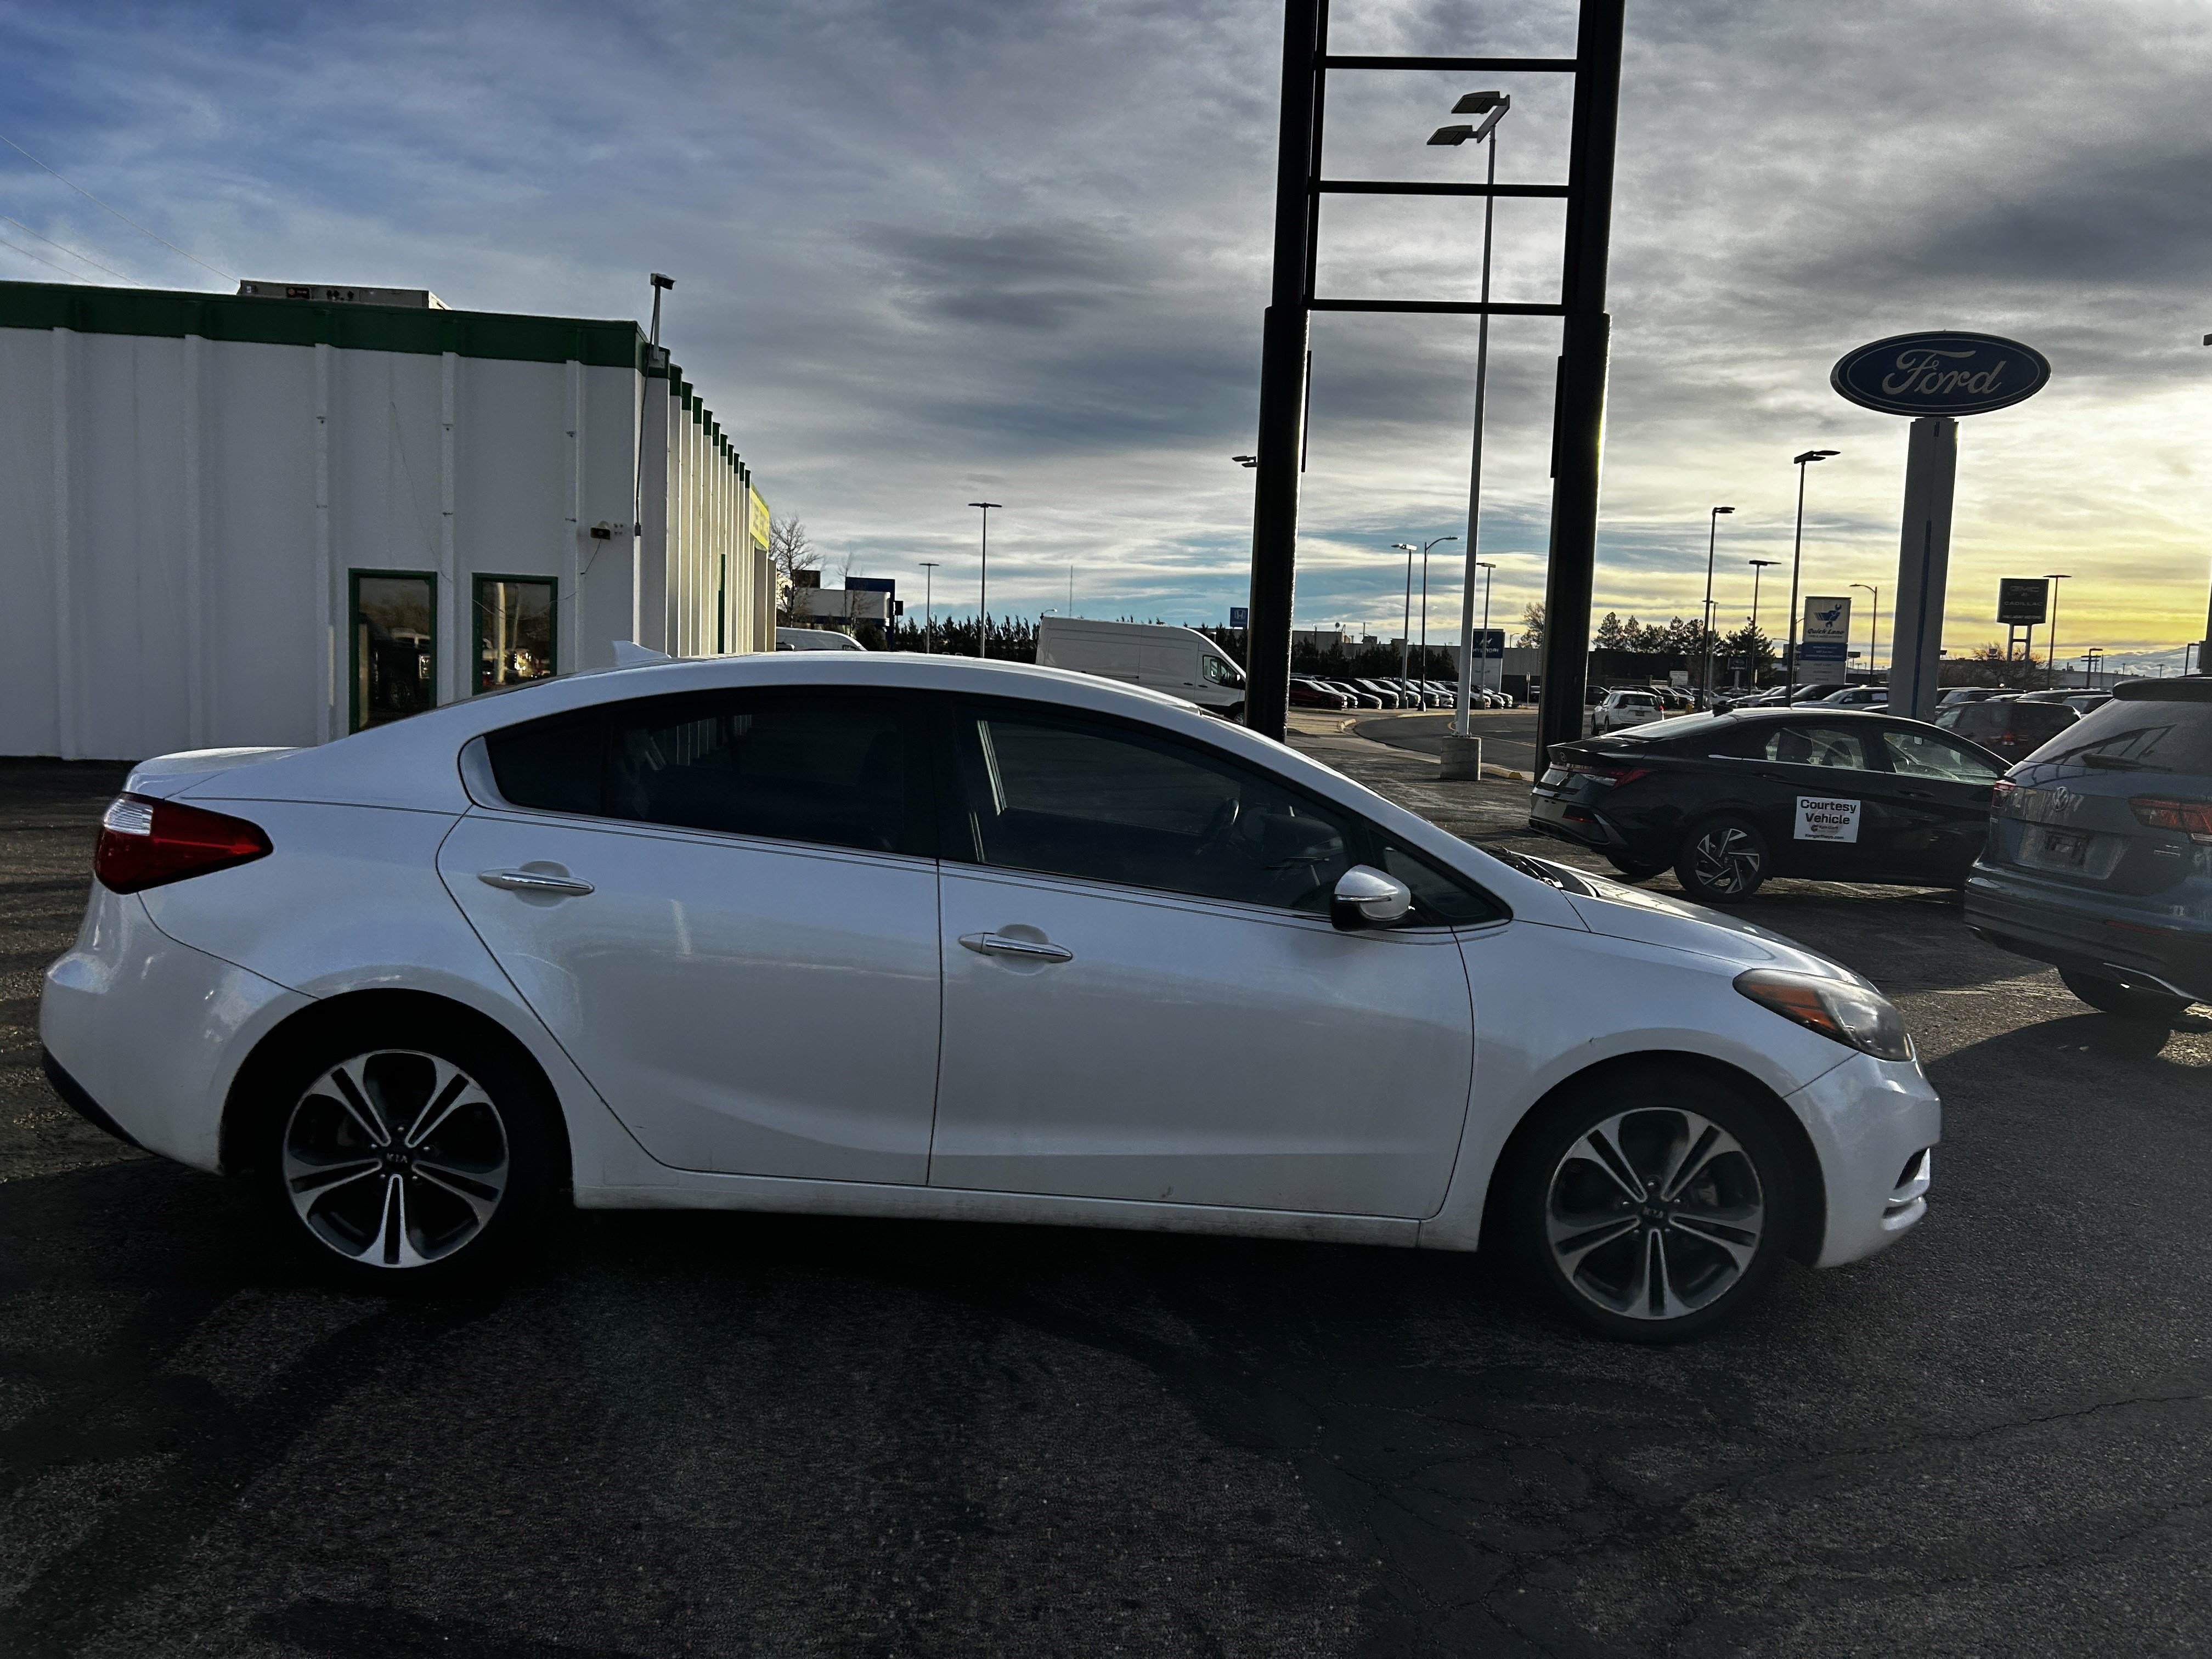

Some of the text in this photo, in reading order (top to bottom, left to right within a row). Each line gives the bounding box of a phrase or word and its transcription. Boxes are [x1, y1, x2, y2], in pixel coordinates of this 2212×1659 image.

[1882, 349, 2007, 395] Ford
[1800, 799, 1857, 814] Courtesy
[1805, 812, 1850, 825] Vehicle
[386, 1153, 408, 1164] KIA
